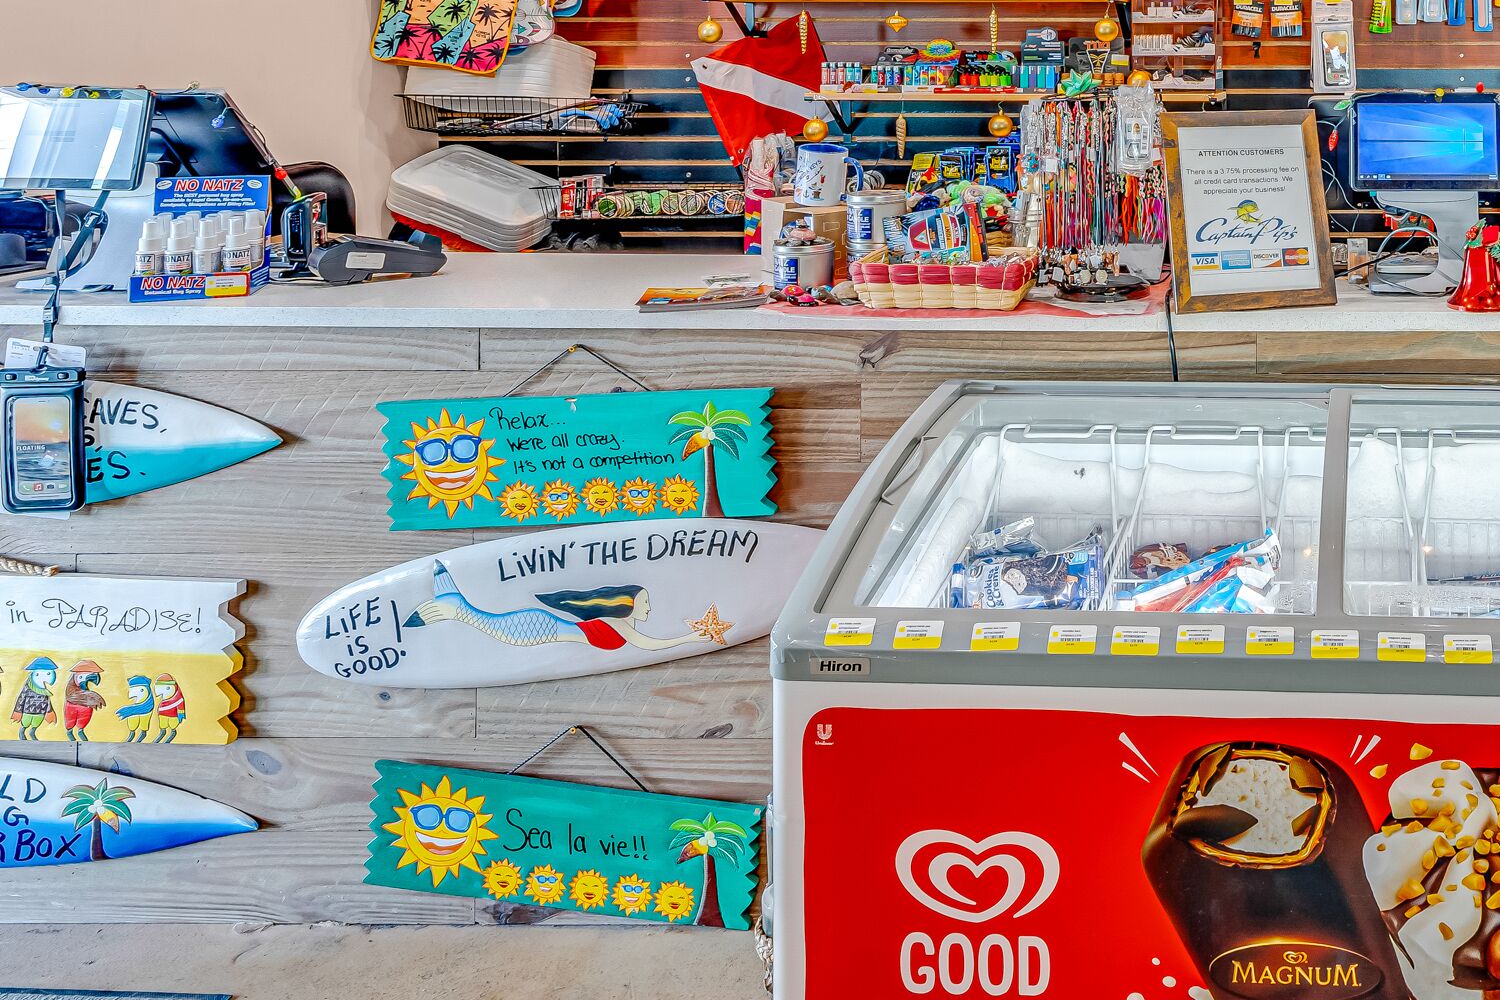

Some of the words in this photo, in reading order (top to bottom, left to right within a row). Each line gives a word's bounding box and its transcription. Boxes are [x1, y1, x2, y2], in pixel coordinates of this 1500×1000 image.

[1198, 149, 1239, 157] ATTENTION
[1239, 148, 1285, 156] CUSTOMERS
[1185, 168, 1206, 176] There
[1242, 167, 1278, 177] processing
[174, 179, 200, 192] NO
[201, 178, 245, 191] NATZ
[1203, 187, 1238, 196] appreciate
[1195, 217, 1257, 245] Captain
[1195, 257, 1216, 265] VISA
[1253, 252, 1280, 260] DISCOVER
[141, 276, 164, 290] NO
[167, 275, 206, 289] NATZ
[551, 432, 569, 449] all
[513, 459, 538, 475] It's
[541, 455, 567, 472] not
[572, 457, 585, 470] a
[589, 450, 676, 471] competition
[587, 534, 637, 566] THE
[647, 528, 760, 565] DREAM
[818, 659, 863, 674] Hiron
[502, 807, 554, 853] Sea
[568, 822, 589, 857] la
[898, 931, 1052, 996] GOOD
[1231, 957, 1360, 989] MAGNUM
